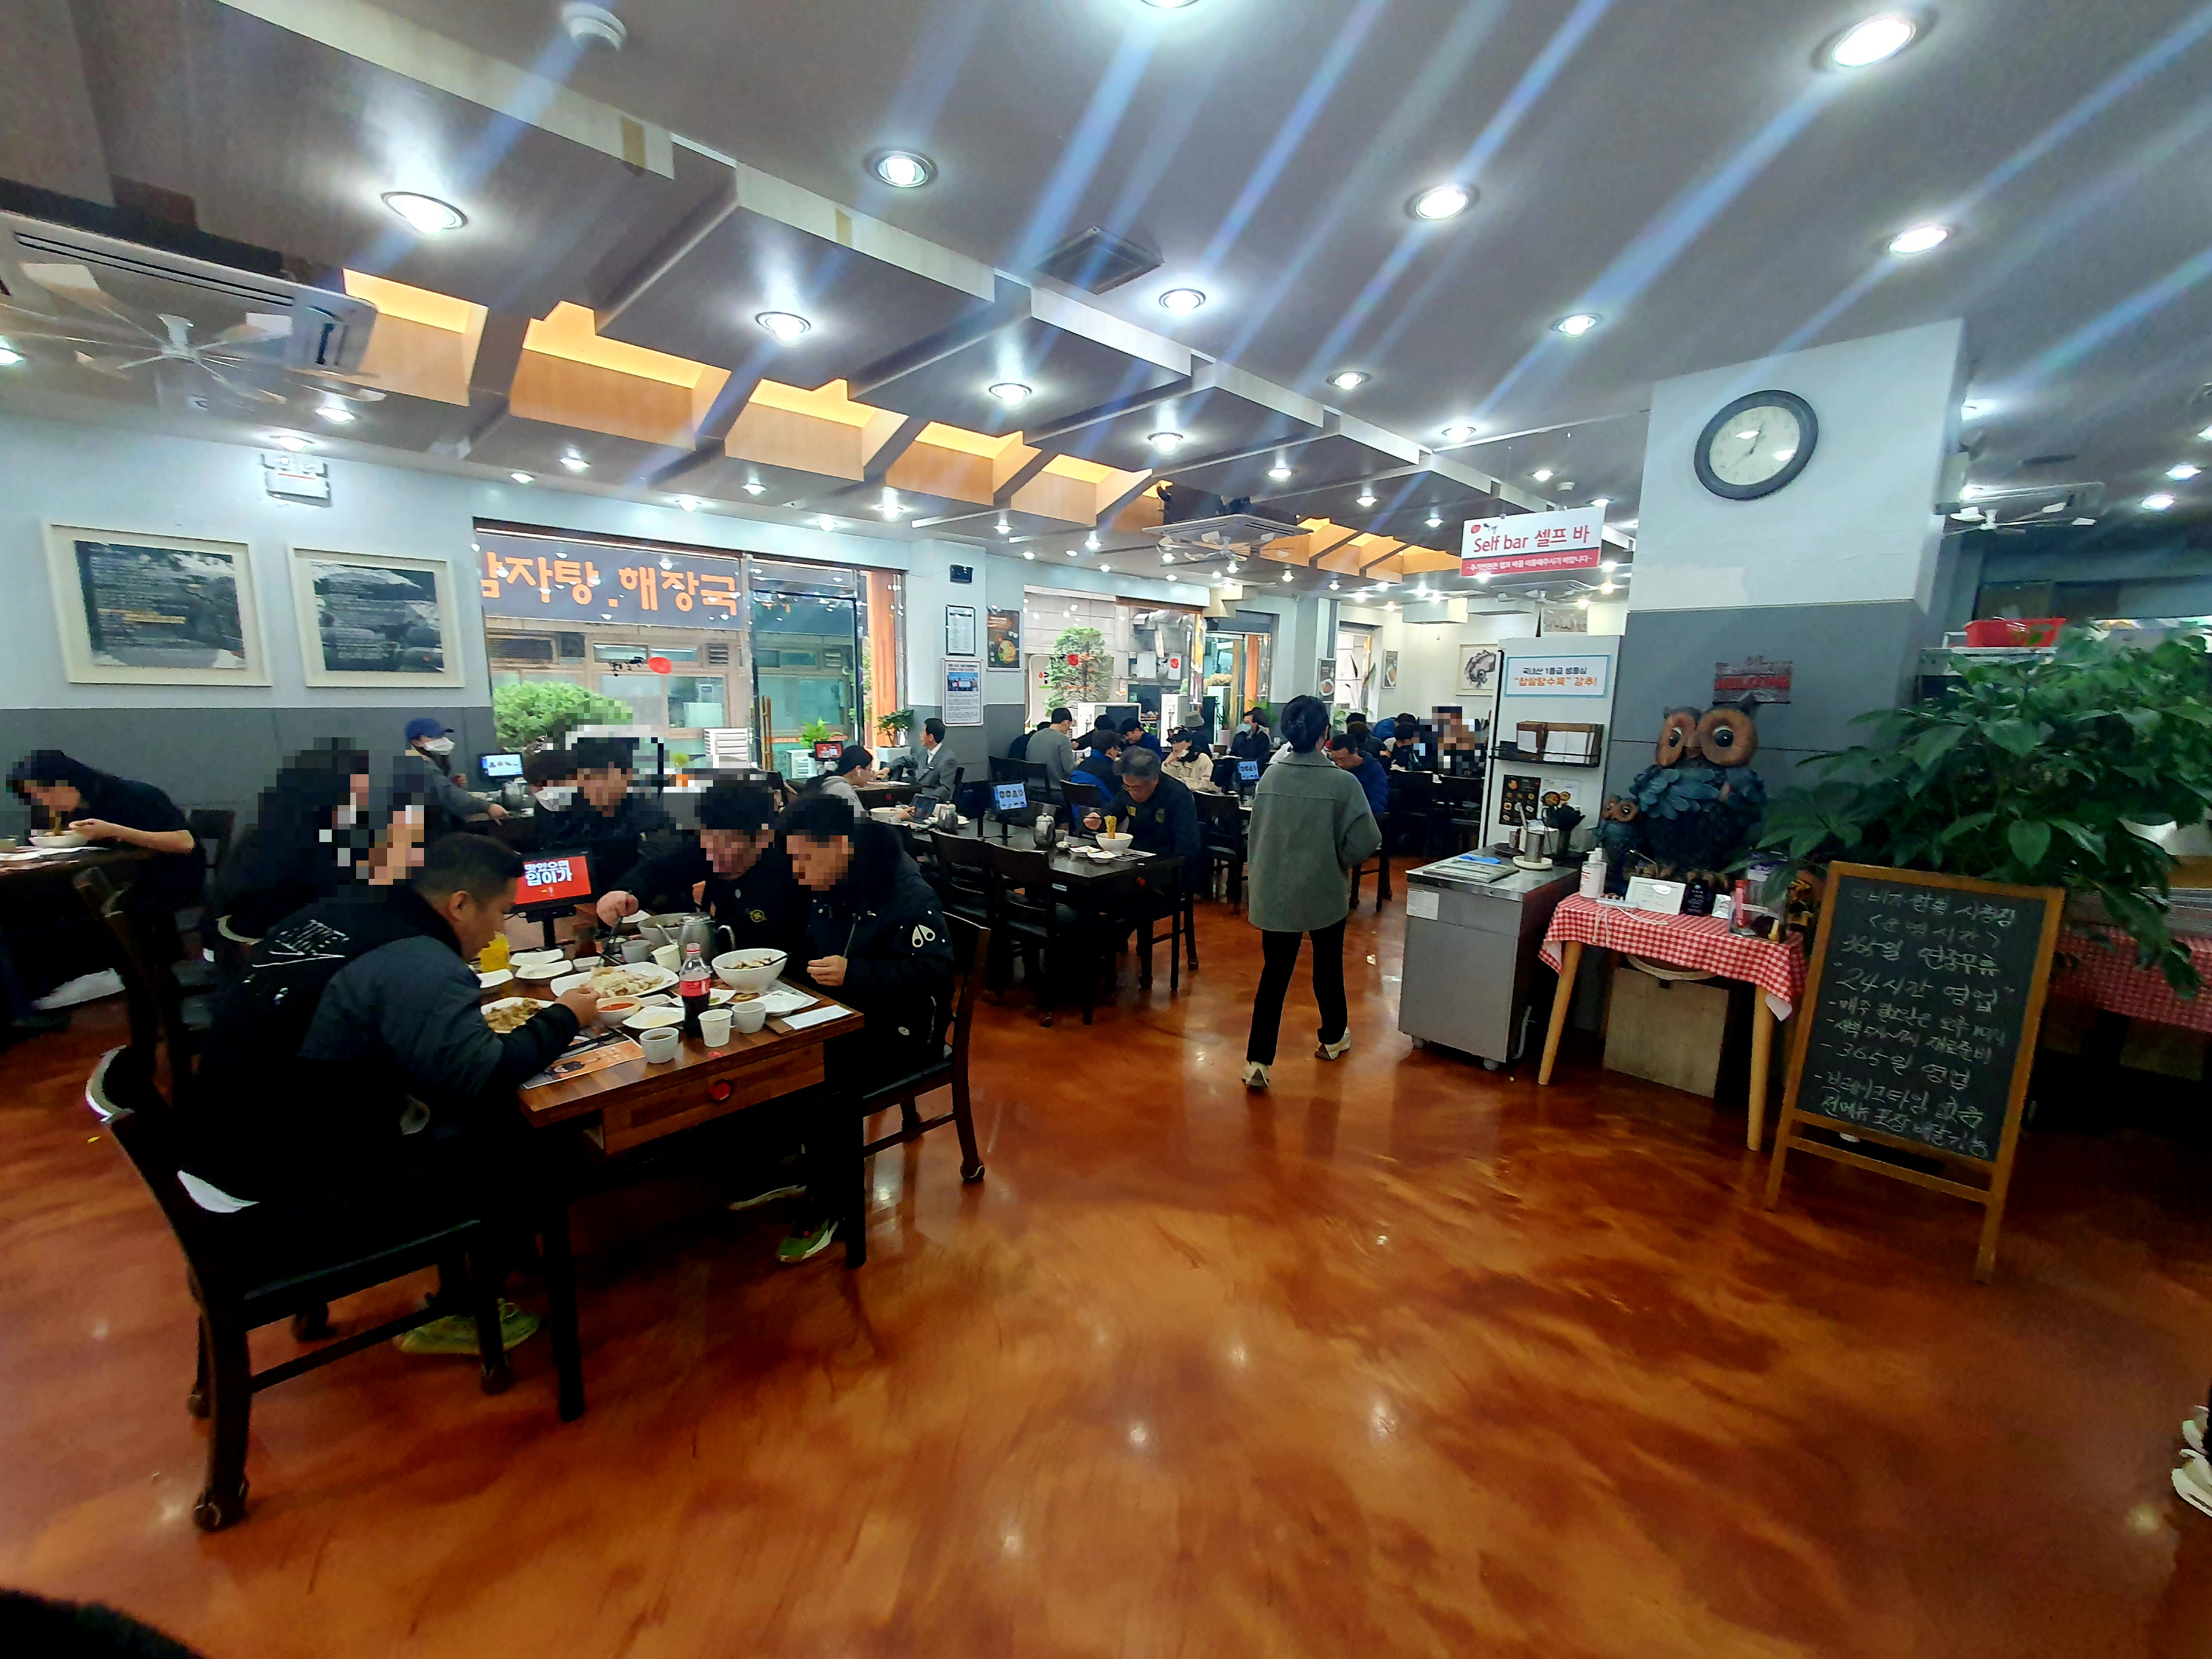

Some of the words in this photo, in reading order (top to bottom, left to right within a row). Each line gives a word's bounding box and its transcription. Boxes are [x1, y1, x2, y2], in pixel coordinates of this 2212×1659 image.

[1473, 535, 1500, 552] Self
[1503, 535, 1528, 550] bar
[1534, 528, 1567, 548] 셀프
[1573, 525, 1590, 544] 바
[1573, 676, 1598, 686] 강추!
